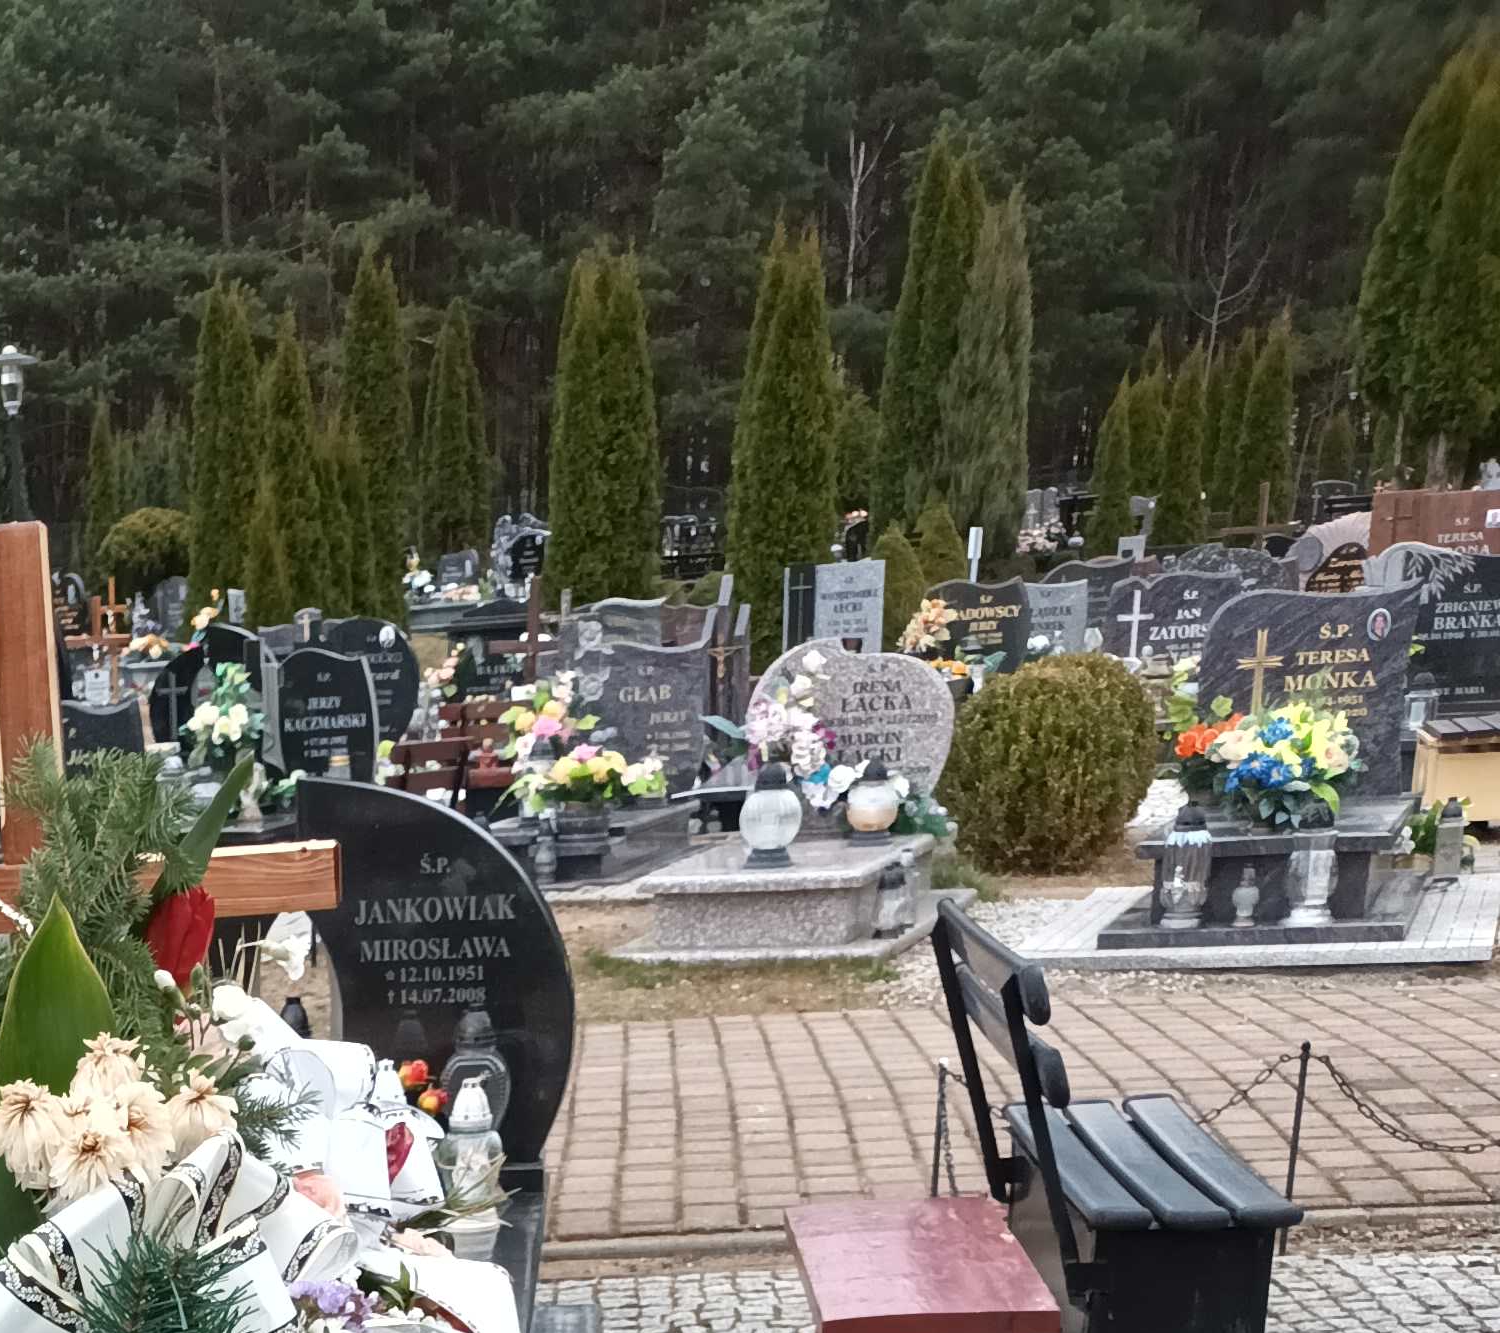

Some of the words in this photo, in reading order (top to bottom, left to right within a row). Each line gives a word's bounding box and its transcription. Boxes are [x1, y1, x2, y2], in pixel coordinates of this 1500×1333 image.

[1437, 531, 1484, 543] TERESA
[1175, 607, 1202, 620] JAN
[1296, 648, 1370, 666] TERESA
[853, 680, 902, 694] IRENA
[419, 852, 451, 874] Ś.P.
[354, 893, 517, 926] JANKOWIAK
[359, 936, 511, 962] MIROSŁAWA
